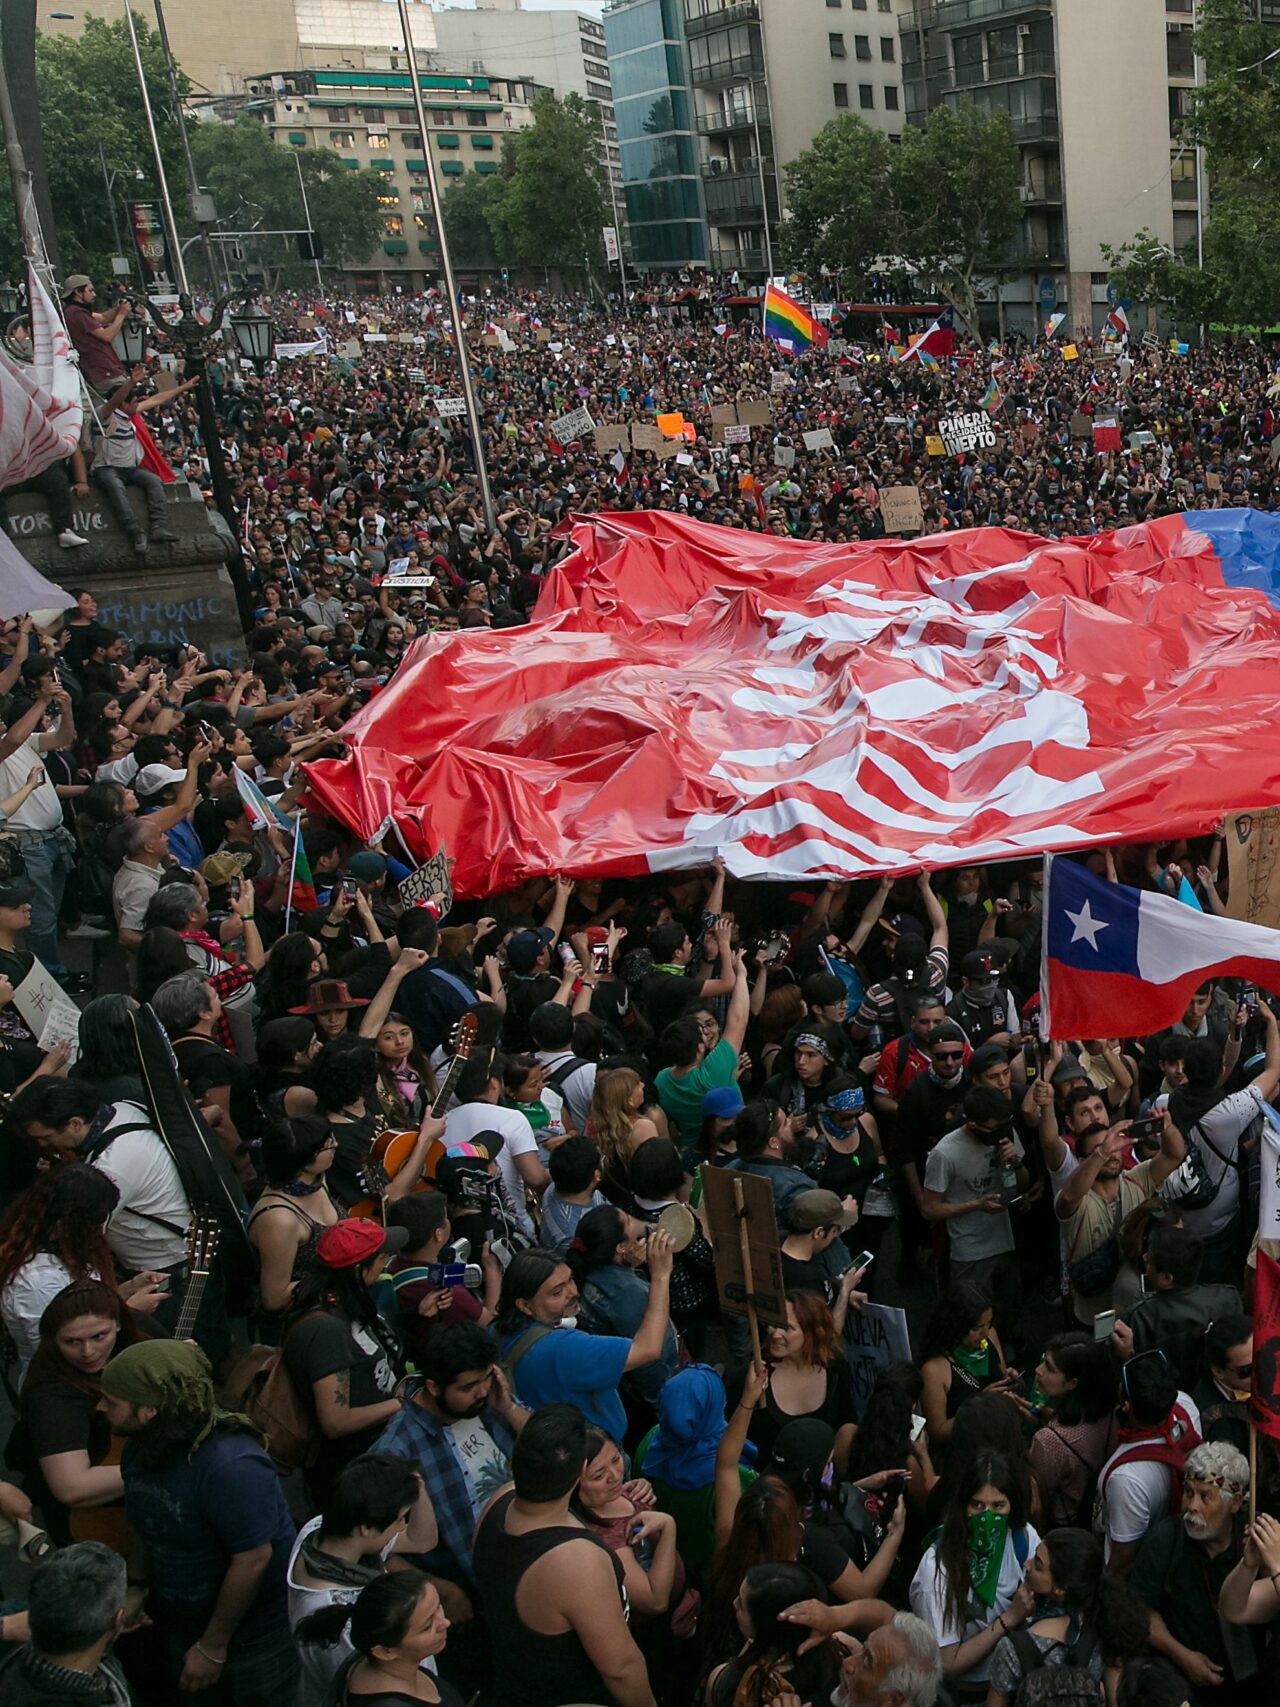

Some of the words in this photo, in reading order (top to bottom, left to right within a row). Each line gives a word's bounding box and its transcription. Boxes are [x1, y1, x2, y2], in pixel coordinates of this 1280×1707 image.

[938, 409, 991, 434] PIÑERA
[942, 423, 991, 442] PRESIDENTE
[944, 431, 997, 457] INEPTO
